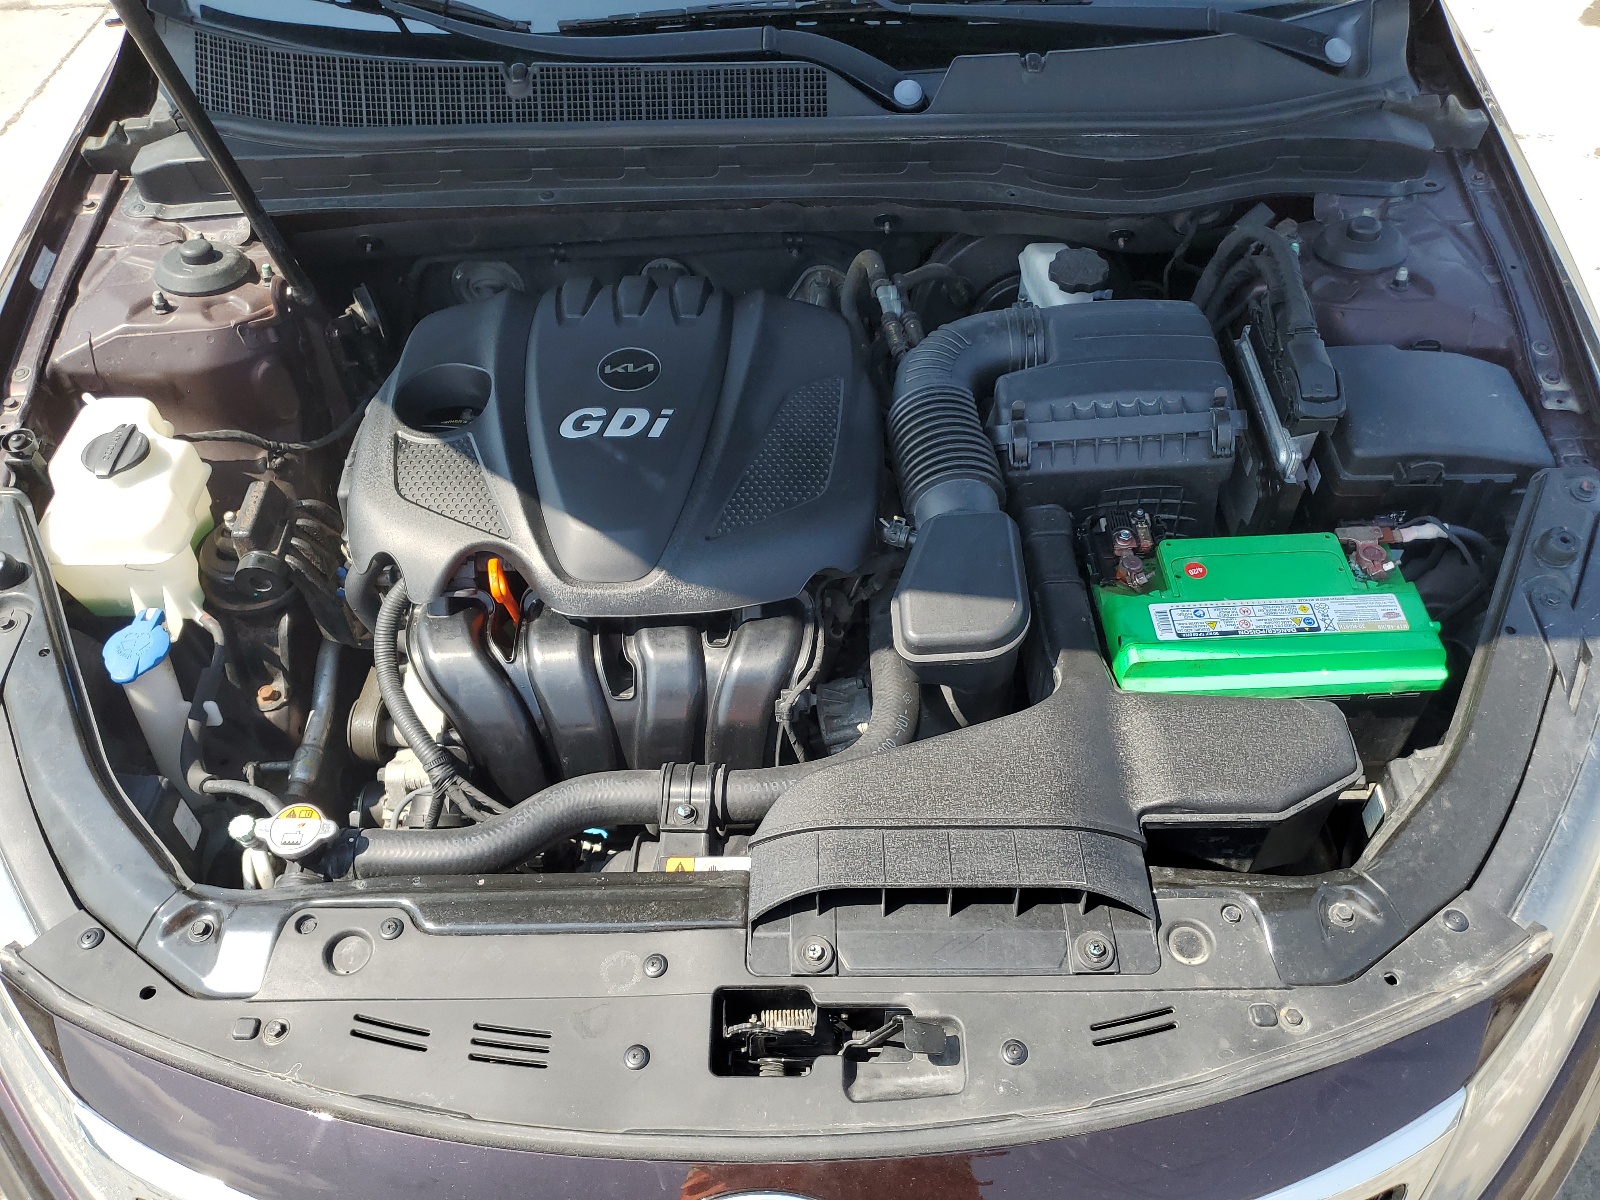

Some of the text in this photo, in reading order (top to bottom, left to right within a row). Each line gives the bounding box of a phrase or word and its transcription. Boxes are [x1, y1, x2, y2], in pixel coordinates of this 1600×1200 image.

[604, 363, 654, 374] KIA
[558, 406, 676, 439] GDi
[1188, 567, 1203, 576] 4/20
